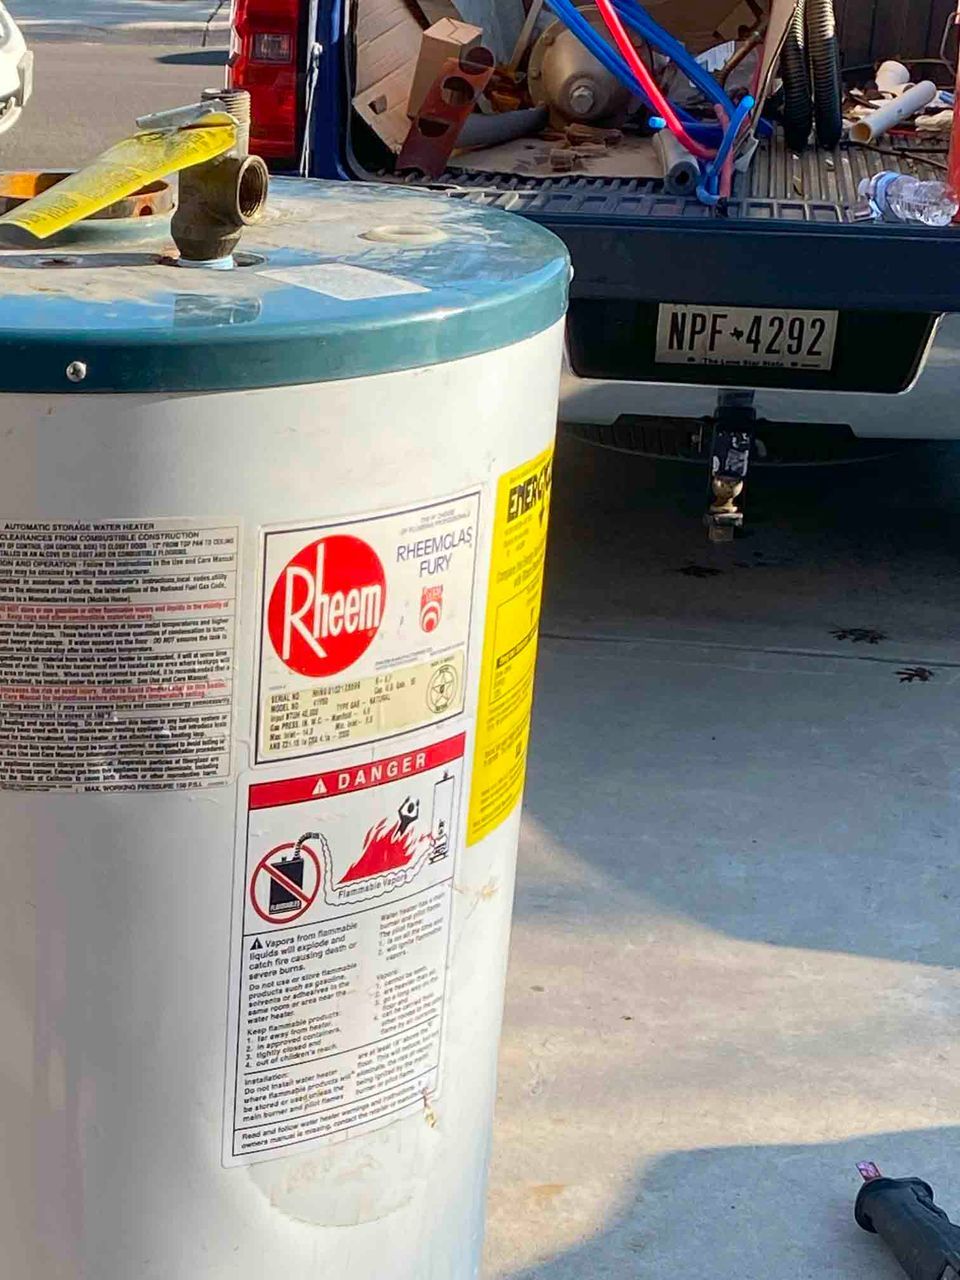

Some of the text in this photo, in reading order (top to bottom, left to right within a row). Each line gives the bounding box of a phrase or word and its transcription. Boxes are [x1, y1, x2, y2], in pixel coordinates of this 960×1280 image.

[668, 311, 825, 355] NPF 4292
[0, 533, 53, 541] CLEARANCES
[54, 534, 77, 542] FROM
[79, 533, 137, 542] COMBUSTIBLE
[138, 531, 200, 541] CONSTRUCTION
[4, 523, 154, 531] AUTOMATIC STORAGE WATER HEATER
[33, 561, 76, 569] OPERATION
[419, 553, 452, 577] FURY
[281, 542, 382, 660] Rheem
[336, 752, 427, 790] DANGER
[265, 922, 358, 948] Vapors from flammable
[249, 942, 357, 971] catch fire causing death or
[250, 935, 345, 962] liquids will explode and
[249, 964, 305, 980] severe burns.
[261, 981, 274, 989] not
[276, 979, 290, 987] use
